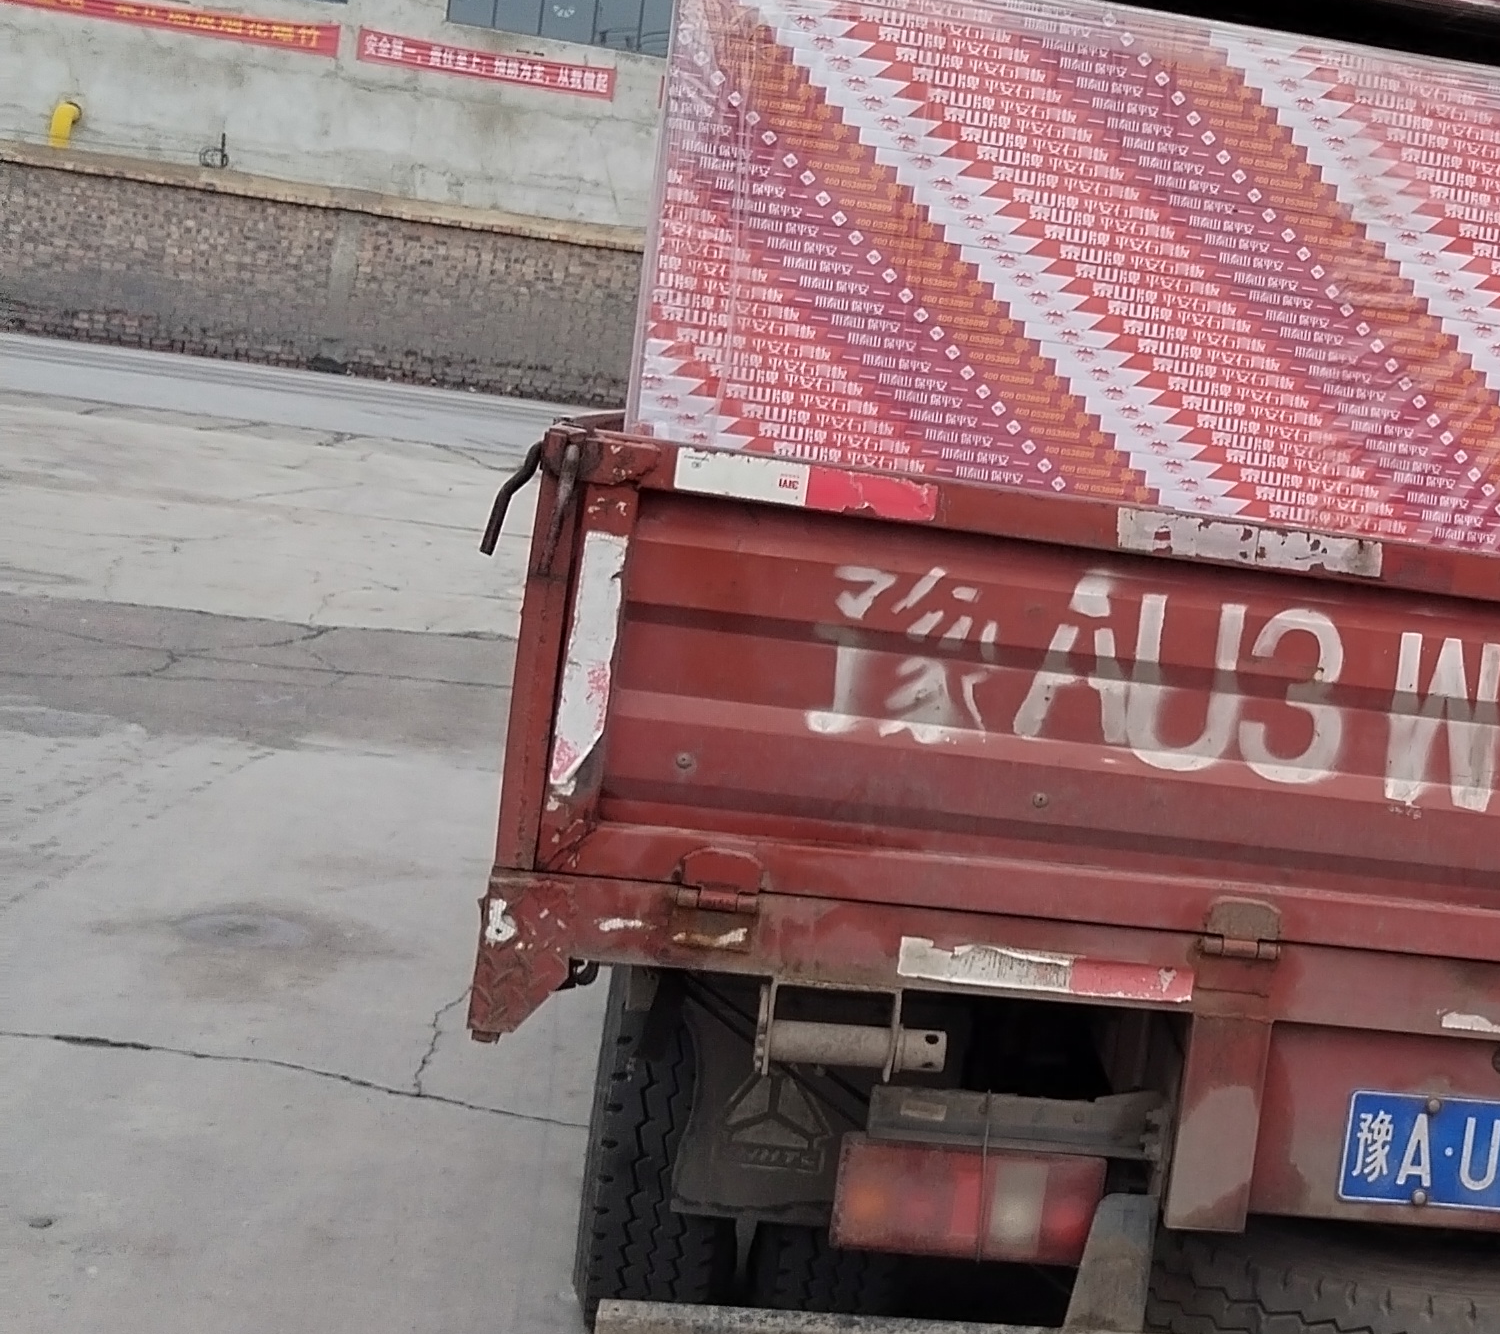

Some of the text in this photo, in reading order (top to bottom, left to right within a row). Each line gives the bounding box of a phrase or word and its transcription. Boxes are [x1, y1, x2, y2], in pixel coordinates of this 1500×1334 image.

[910, 66, 980, 89] 泰山牌
[977, 145, 1043, 167] 泰山牌
[1044, 224, 1110, 246] 泰山牌
[661, 305, 731, 329] 泰山牌
[1108, 300, 1172, 321] 泰山牌
[1153, 357, 1217, 378] 泰山牌
[758, 421, 826, 444] 泰山牌
